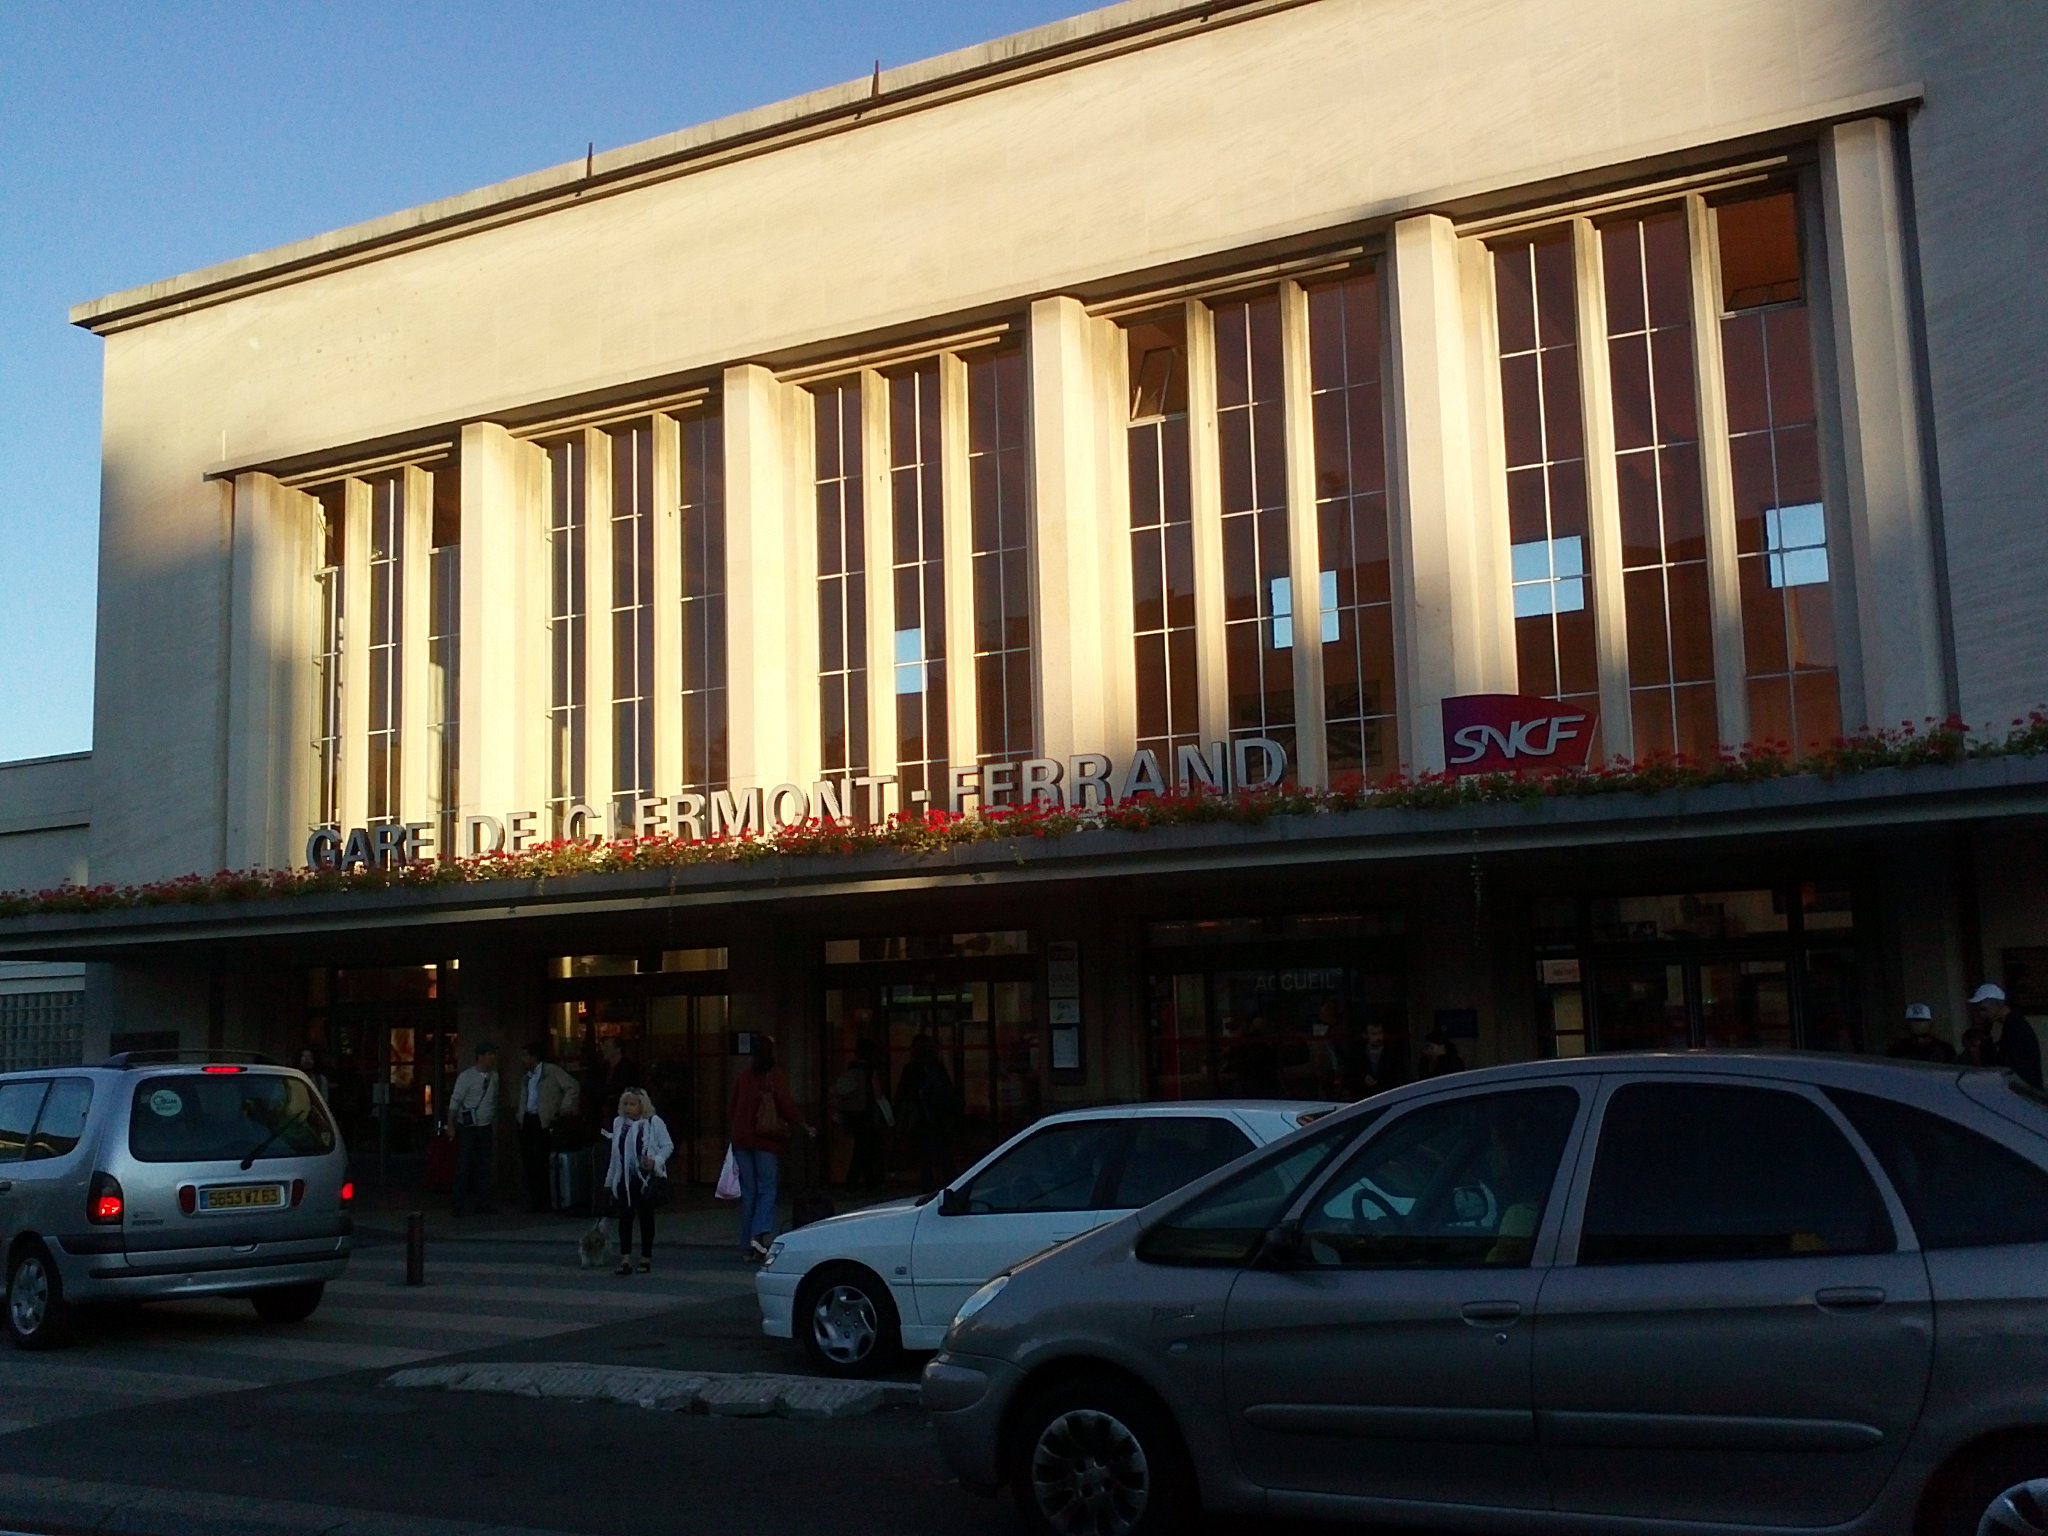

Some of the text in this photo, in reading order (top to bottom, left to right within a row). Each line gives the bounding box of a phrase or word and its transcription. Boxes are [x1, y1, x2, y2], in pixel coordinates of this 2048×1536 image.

[1450, 714, 1585, 764] SNCF
[306, 822, 435, 870] GARE
[466, 811, 537, 860] DE
[562, 776, 897, 846] CLERMONT
[950, 737, 1287, 820] FERRAND
[1255, 972, 1336, 992] ACCUEIL
